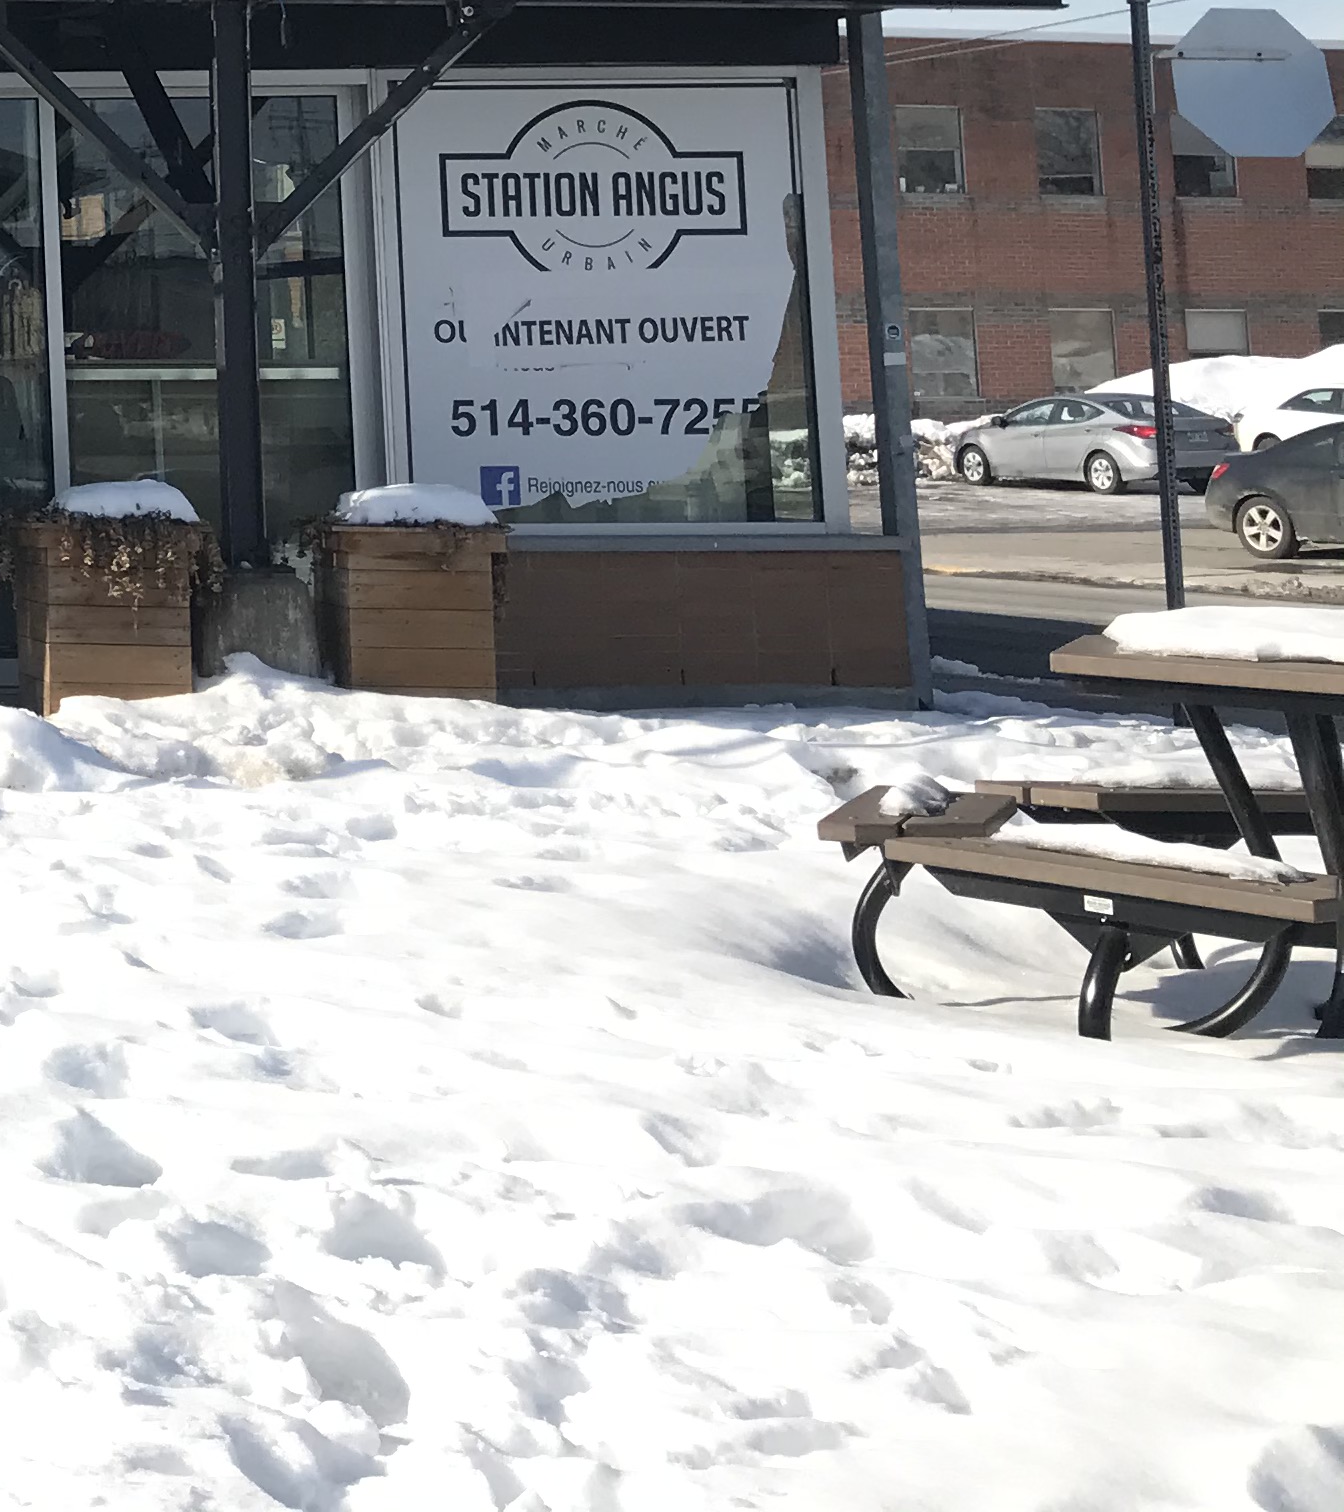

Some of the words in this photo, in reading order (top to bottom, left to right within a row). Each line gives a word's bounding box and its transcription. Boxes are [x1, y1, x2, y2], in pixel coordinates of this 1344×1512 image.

[461, 172, 600, 218] STATION
[612, 171, 725, 216] ANGUS
[541, 238, 652, 271] URBAIN
[638, 315, 750, 344] OUVERT
[527, 477, 644, 498] Rejoignez-nous
